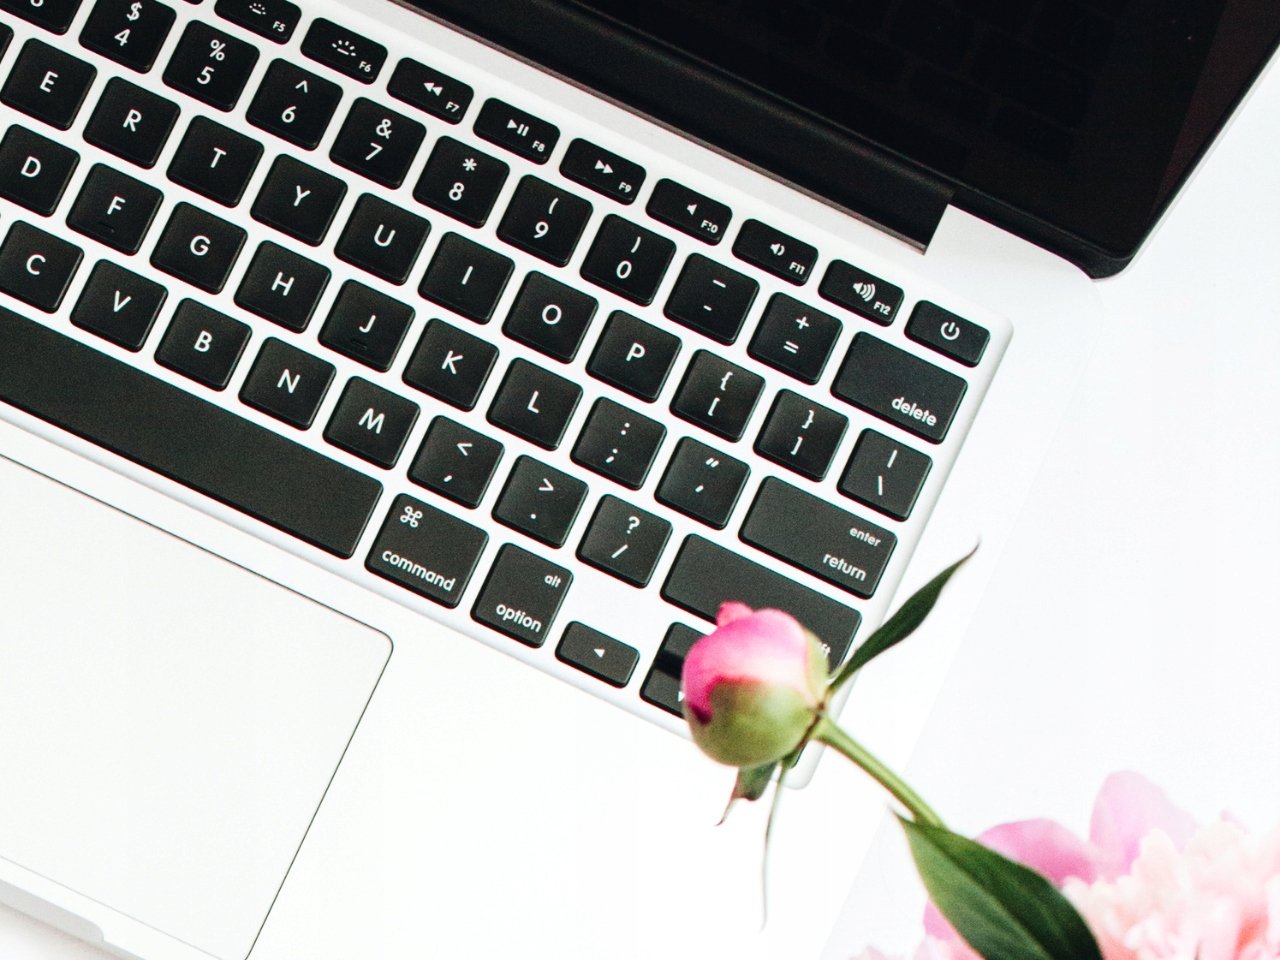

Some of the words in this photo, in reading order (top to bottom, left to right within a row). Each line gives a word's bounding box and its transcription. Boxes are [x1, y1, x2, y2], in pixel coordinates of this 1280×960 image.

[126, 1, 143, 21] $
[272, 20, 286, 32] F5
[114, 28, 131, 47] 4
[209, 39, 226, 61] %
[196, 66, 215, 85] 5
[359, 60, 372, 73] F6
[39, 70, 59, 93] E
[281, 105, 297, 123] 6
[445, 101, 460, 113] F7
[122, 108, 142, 132] R
[375, 118, 392, 139] &
[365, 142, 383, 161] 7
[532, 140, 545, 152] F8
[20, 155, 42, 178] D
[210, 147, 227, 169] T
[293, 185, 311, 207] Y
[448, 182, 465, 201] 8
[618, 181, 632, 193] F9
[106, 195, 126, 215] F
[548, 197, 559, 215] (
[373, 224, 396, 247] U
[533, 221, 549, 239] 9
[189, 235, 211, 256] G
[630, 236, 641, 253] )
[26, 254, 46, 276] C
[461, 265, 474, 285] I
[789, 261, 806, 275] F11
[271, 271, 295, 296] H
[113, 290, 132, 313] V
[873, 301, 891, 316] F12
[358, 314, 377, 333] J
[541, 304, 562, 325] O
[795, 316, 810, 330] +
[193, 330, 213, 353] B
[783, 340, 799, 354] =
[625, 342, 646, 362] P
[441, 350, 464, 375] K
[276, 368, 301, 394] N
[719, 371, 734, 391] {
[527, 390, 540, 414] L
[707, 397, 721, 417] [
[891, 396, 937, 427] delete
[358, 407, 385, 434] M
[801, 409, 815, 430] }
[790, 436, 804, 456] ]
[626, 515, 641, 535] ?
[849, 527, 882, 547] enter
[381, 550, 457, 592] command
[822, 553, 867, 582] return
[544, 574, 562, 588] alt
[495, 603, 542, 633] option
